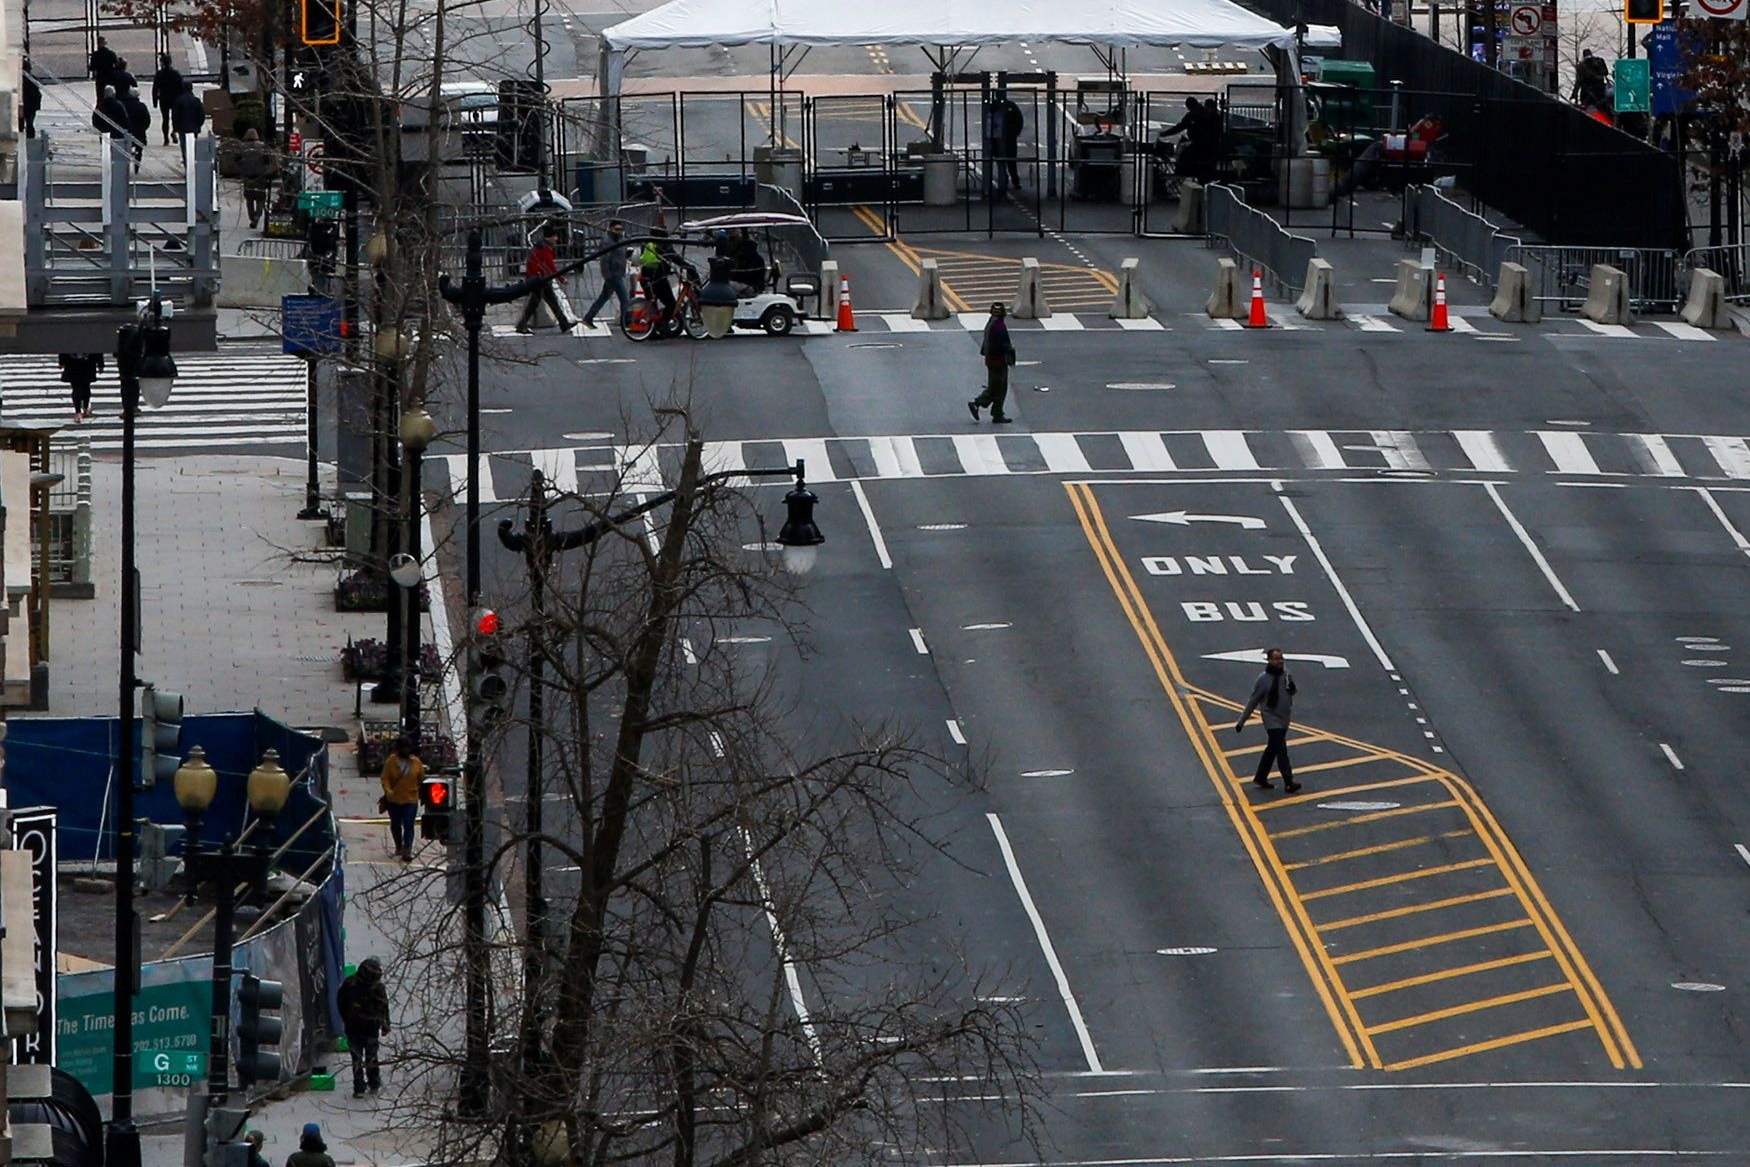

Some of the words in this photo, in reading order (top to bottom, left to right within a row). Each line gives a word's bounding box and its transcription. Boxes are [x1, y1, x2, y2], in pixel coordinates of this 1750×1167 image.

[1141, 555, 1299, 575] ONLY
[1181, 600, 1317, 622] BUS
[57, 1019, 78, 1036] The
[83, 1014, 115, 1032] Time
[149, 1005, 190, 1024] Come.
[154, 1053, 170, 1071] G
[185, 1055, 198, 1063] ST
[156, 1074, 191, 1086] 1300
